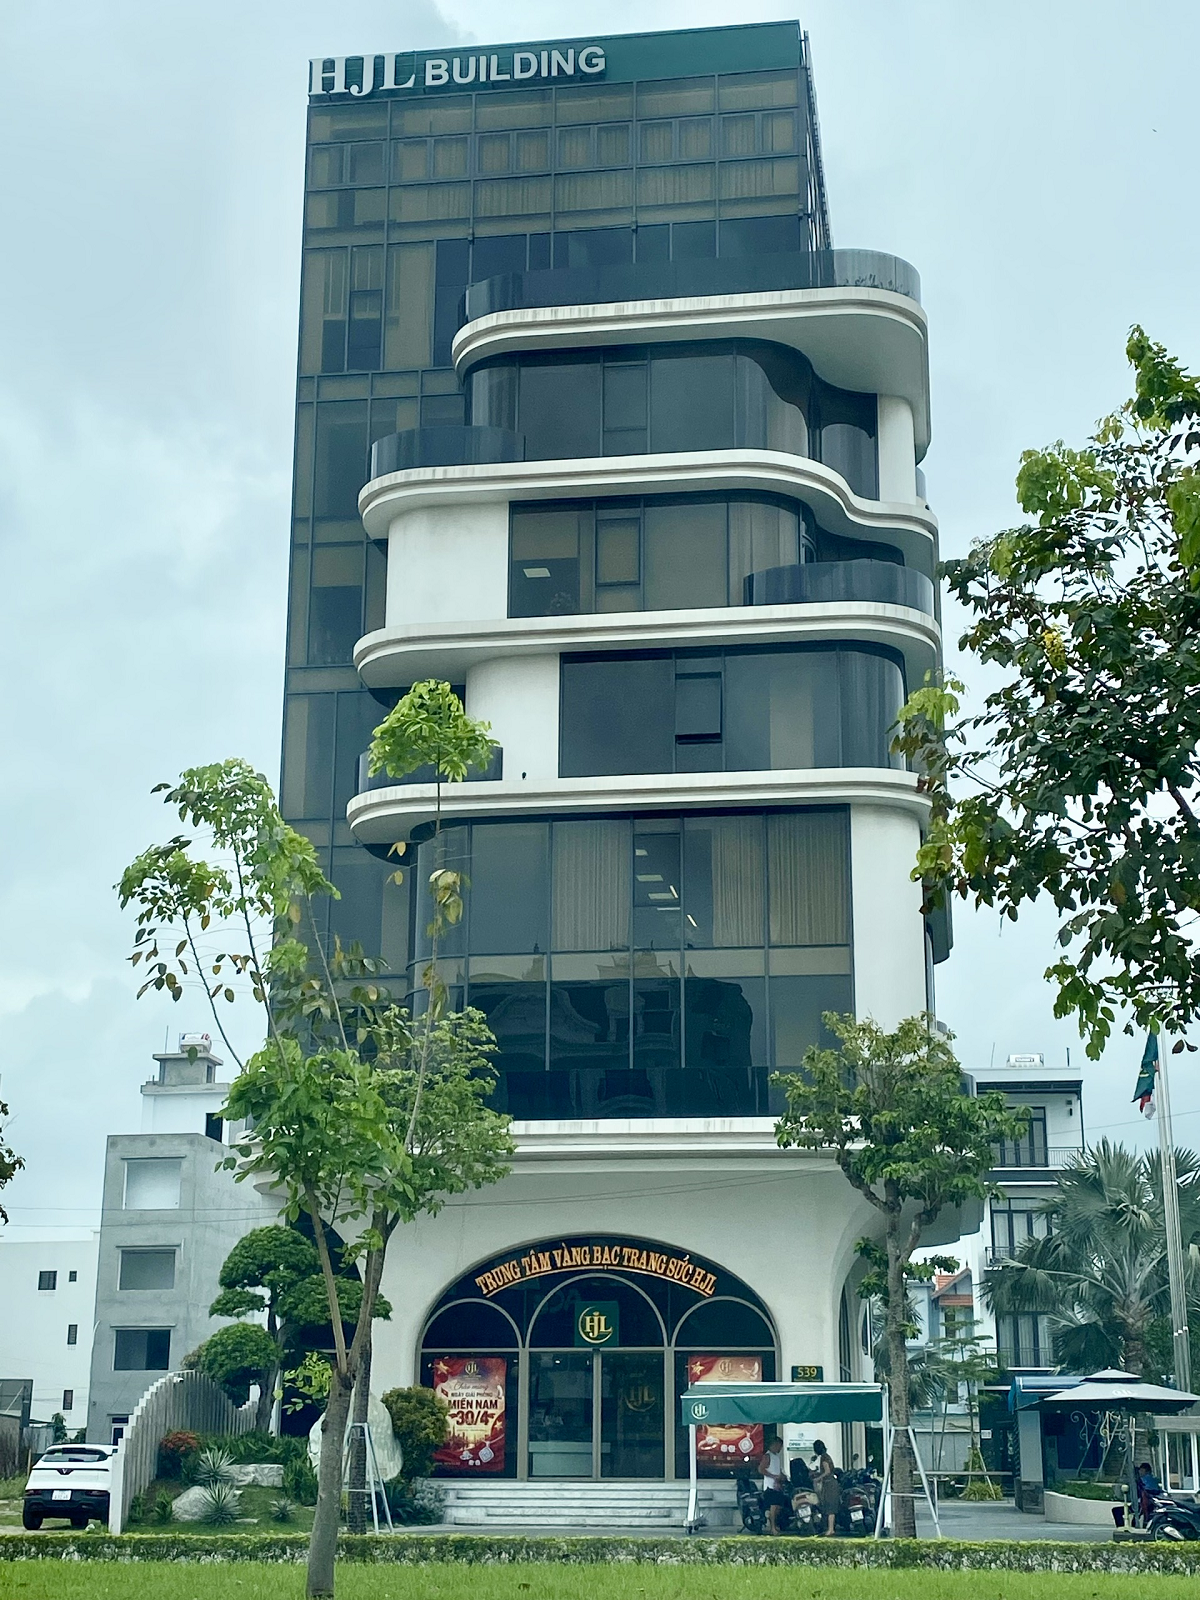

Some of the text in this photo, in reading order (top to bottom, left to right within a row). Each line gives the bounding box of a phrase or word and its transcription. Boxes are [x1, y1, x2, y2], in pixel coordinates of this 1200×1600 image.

[308, 46, 606, 96] HJL BUILDING
[475, 1260, 521, 1295] TRUNG
[521, 1249, 552, 1276] TÂM
[552, 1242, 590, 1267] VÀNG
[622, 1247, 668, 1274] TRANG
[665, 1254, 694, 1283] SỨC
[690, 1266, 718, 1296] HJL
[797, 1366, 818, 1378] 539
[476, 1399, 498, 1410] NAM
[456, 1410, 489, 1426] 30/4
